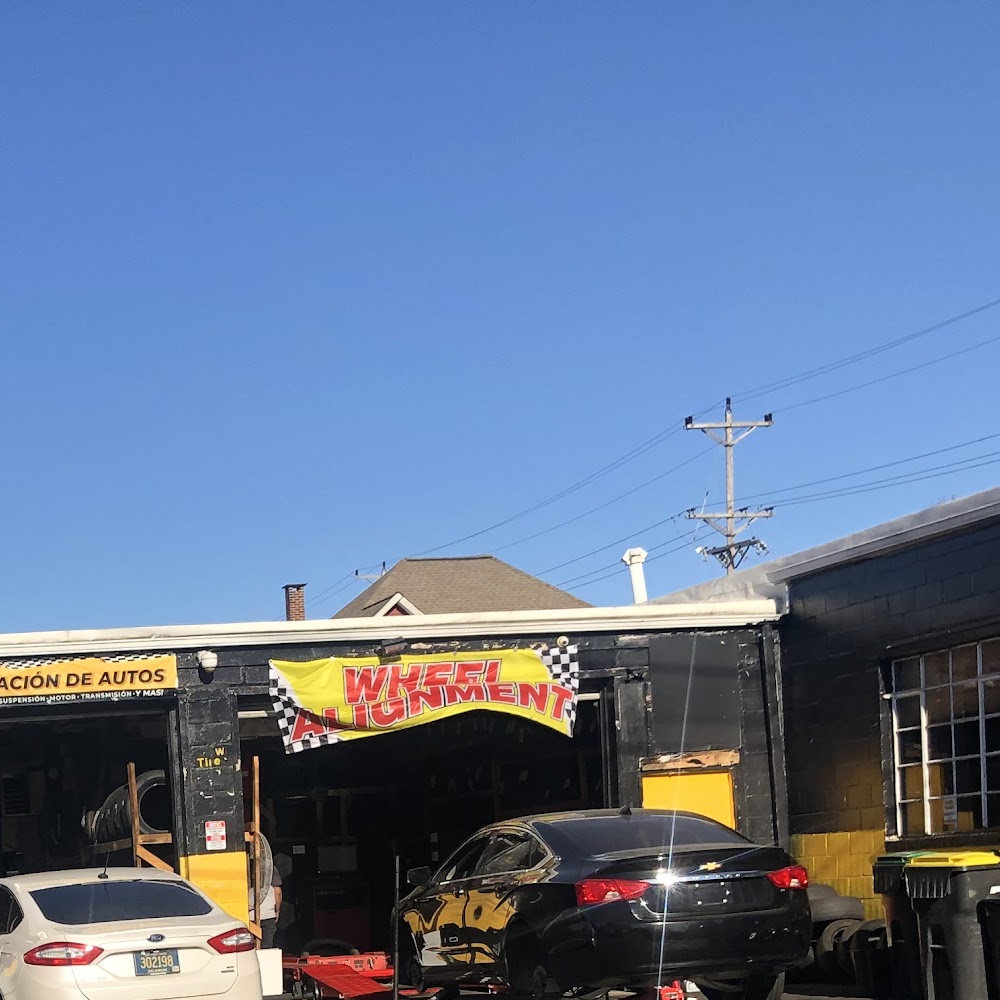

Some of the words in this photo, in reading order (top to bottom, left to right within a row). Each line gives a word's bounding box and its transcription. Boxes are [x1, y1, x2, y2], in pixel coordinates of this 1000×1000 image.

[66, 673, 92, 687] DE
[98, 669, 165, 685] AUTOS
[342, 659, 502, 705] WHEEL
[49, 694, 76, 702] MOTOR
[81, 691, 132, 699] TRANSMISIÓN
[289, 682, 575, 743] ALIGNMENT
[140, 955, 174, 969] 302198
